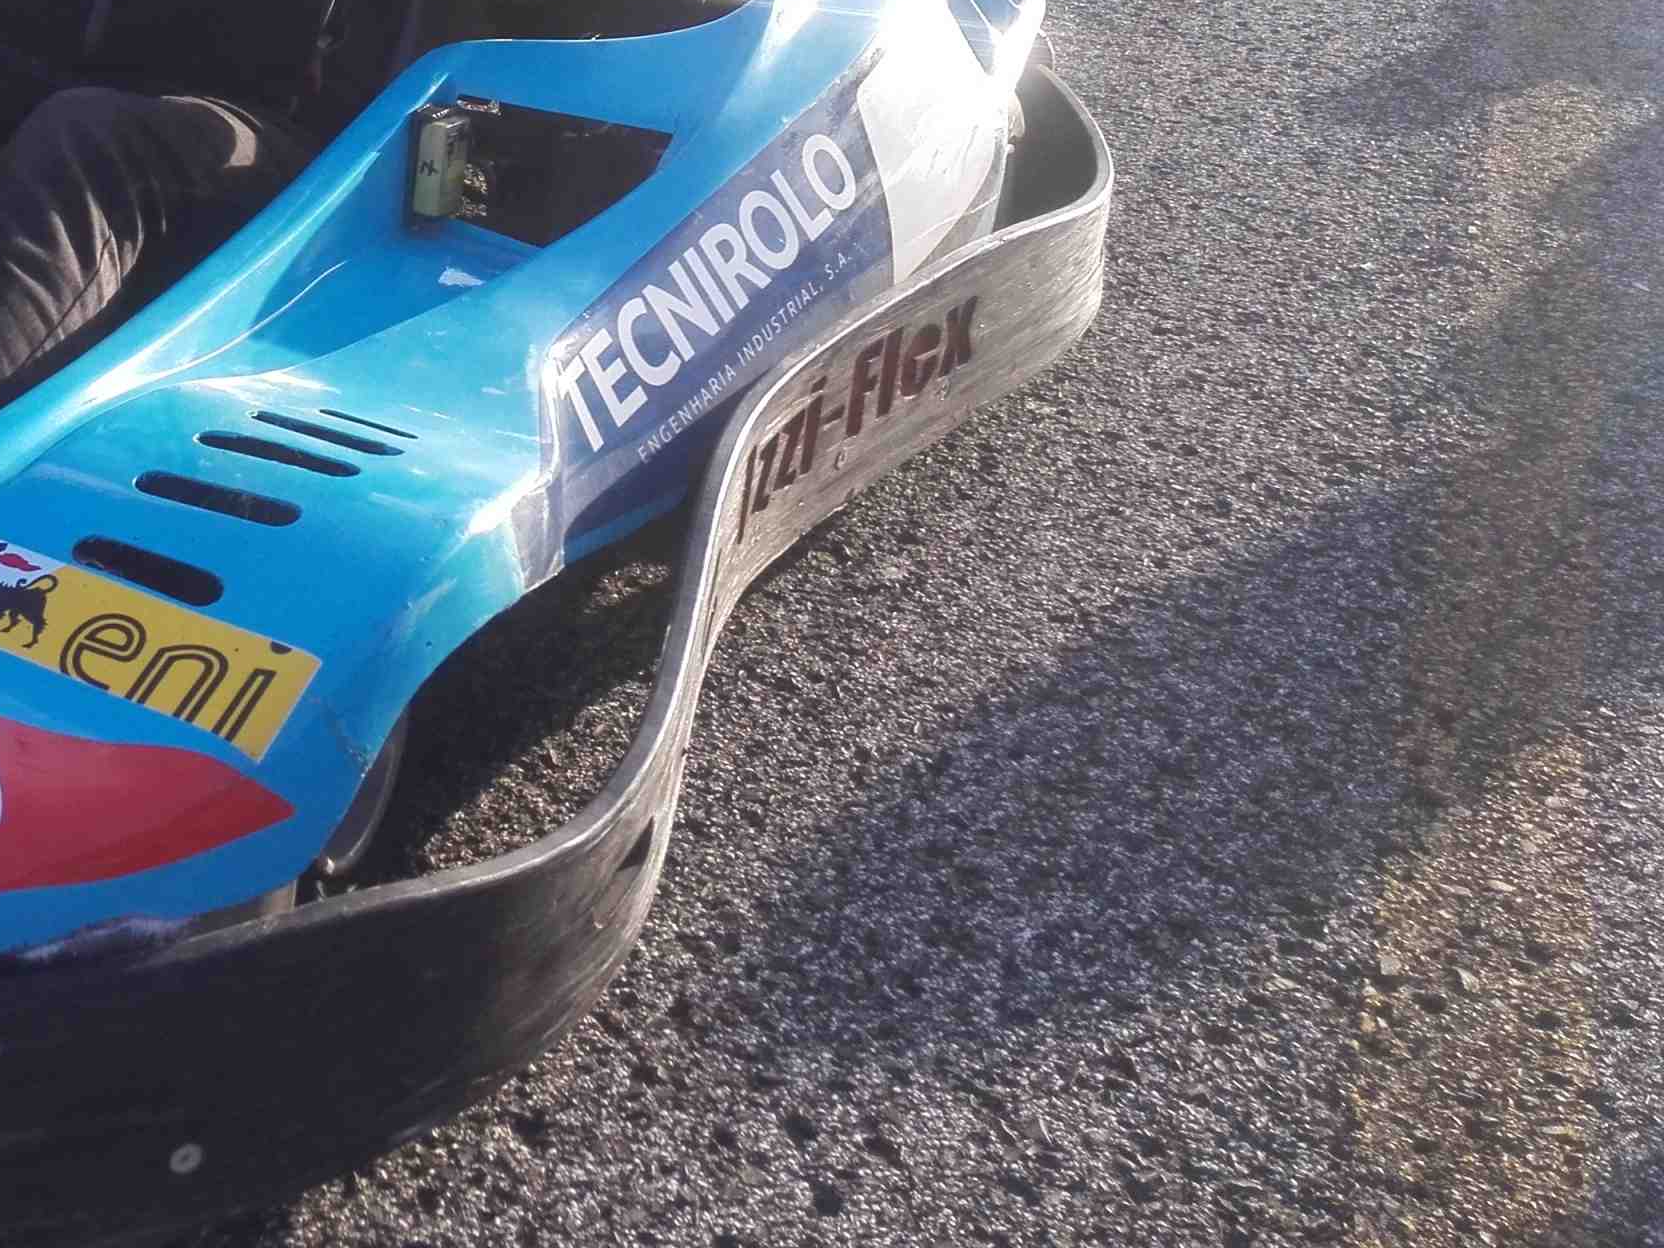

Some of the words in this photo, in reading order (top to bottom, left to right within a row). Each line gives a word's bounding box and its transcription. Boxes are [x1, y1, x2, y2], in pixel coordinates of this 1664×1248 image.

[549, 133, 857, 453] TECNIROLO
[637, 363, 737, 465] ENGENHARIA
[58, 612, 293, 745] eni
